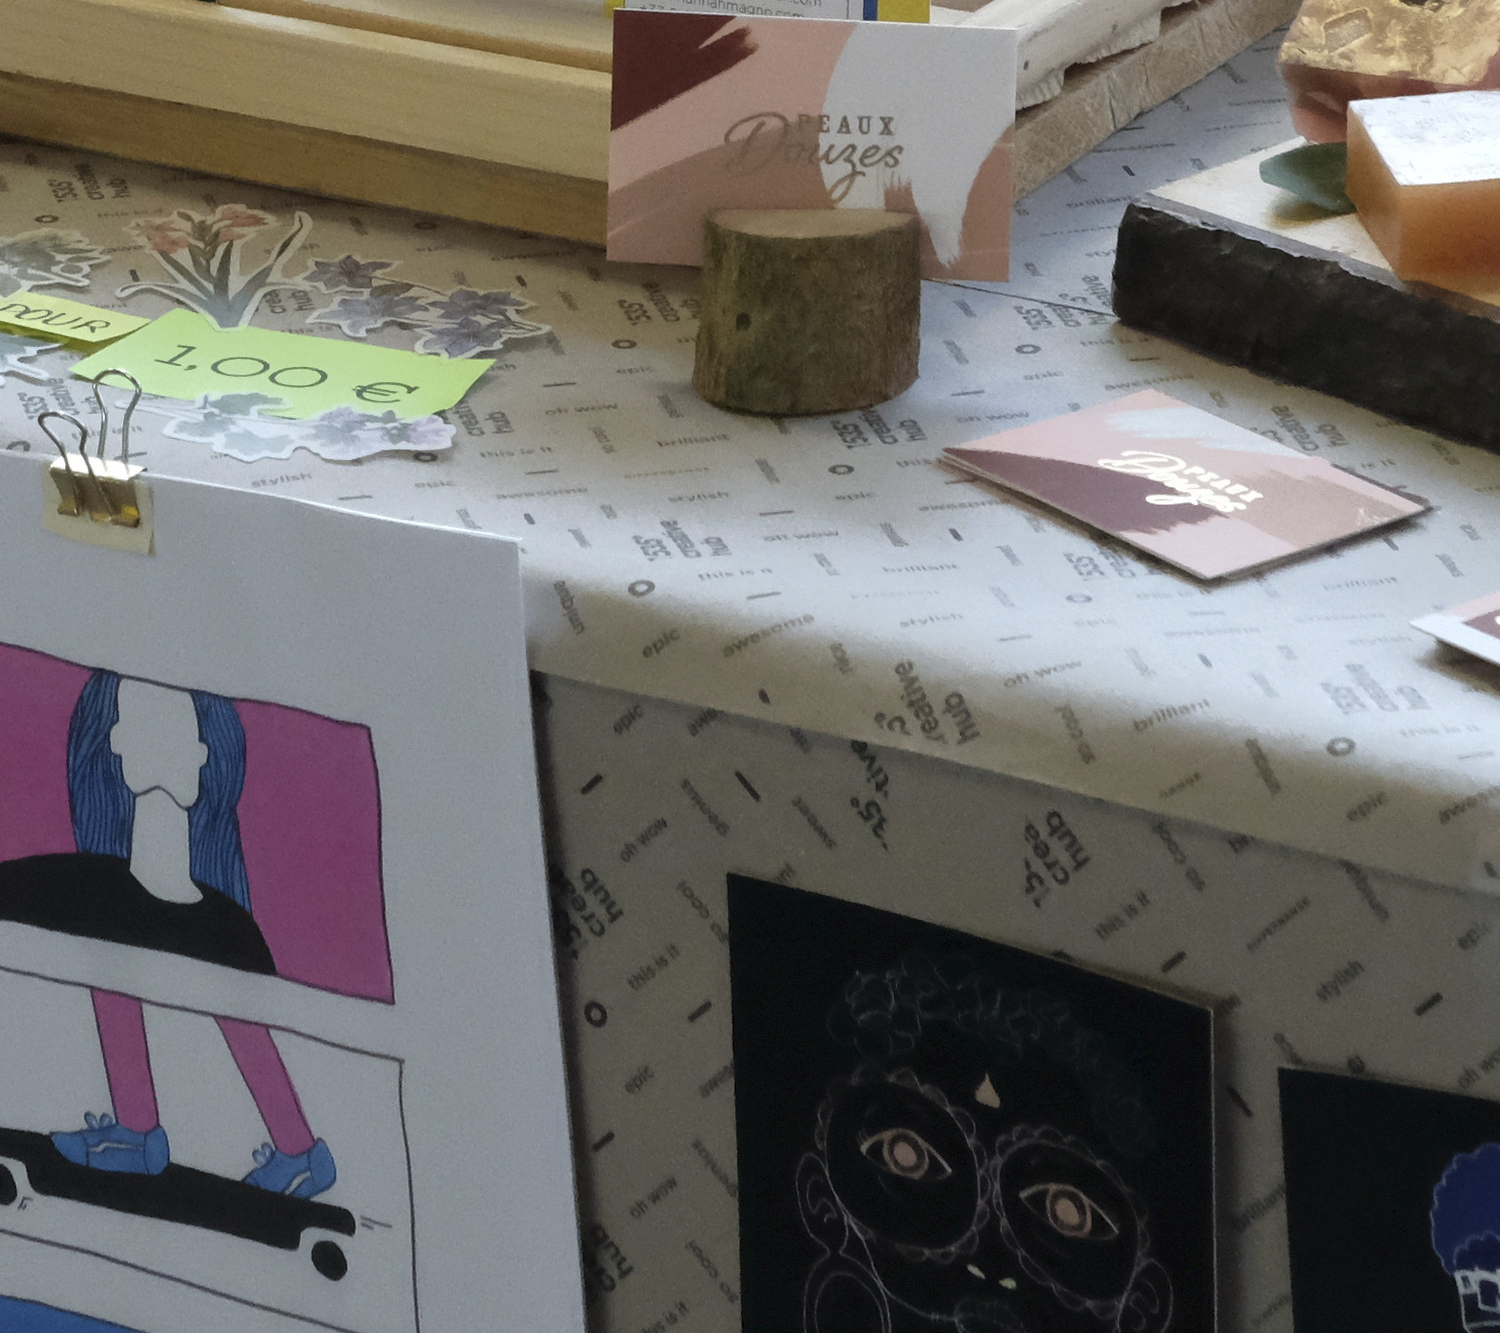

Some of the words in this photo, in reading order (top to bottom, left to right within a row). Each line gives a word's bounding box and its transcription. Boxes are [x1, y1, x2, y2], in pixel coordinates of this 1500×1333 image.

[154, 343, 328, 390] 1,00
[353, 381, 422, 405] €
[642, 627, 682, 659] epic
[944, 689, 981, 747] hub
[1133, 696, 1212, 735] brilliant
[1346, 788, 1391, 824] epic
[1046, 808, 1093, 874] hub
